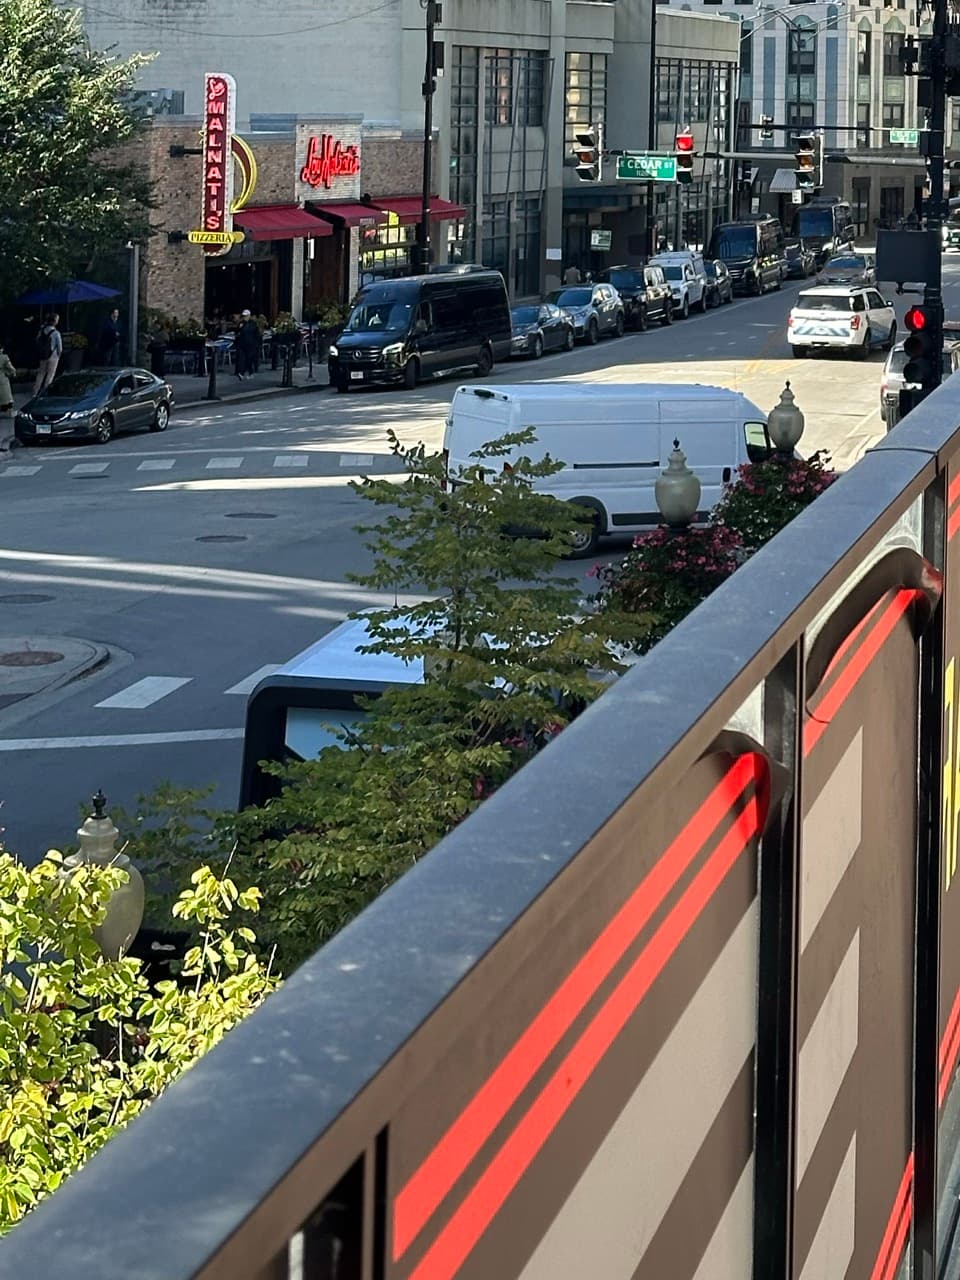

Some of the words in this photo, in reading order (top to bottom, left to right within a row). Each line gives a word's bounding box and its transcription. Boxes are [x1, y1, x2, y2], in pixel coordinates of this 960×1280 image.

[207, 101, 225, 230] MALNATI'S
[627, 159, 663, 169] CEDAR
[190, 233, 232, 244] PIZZERIA
